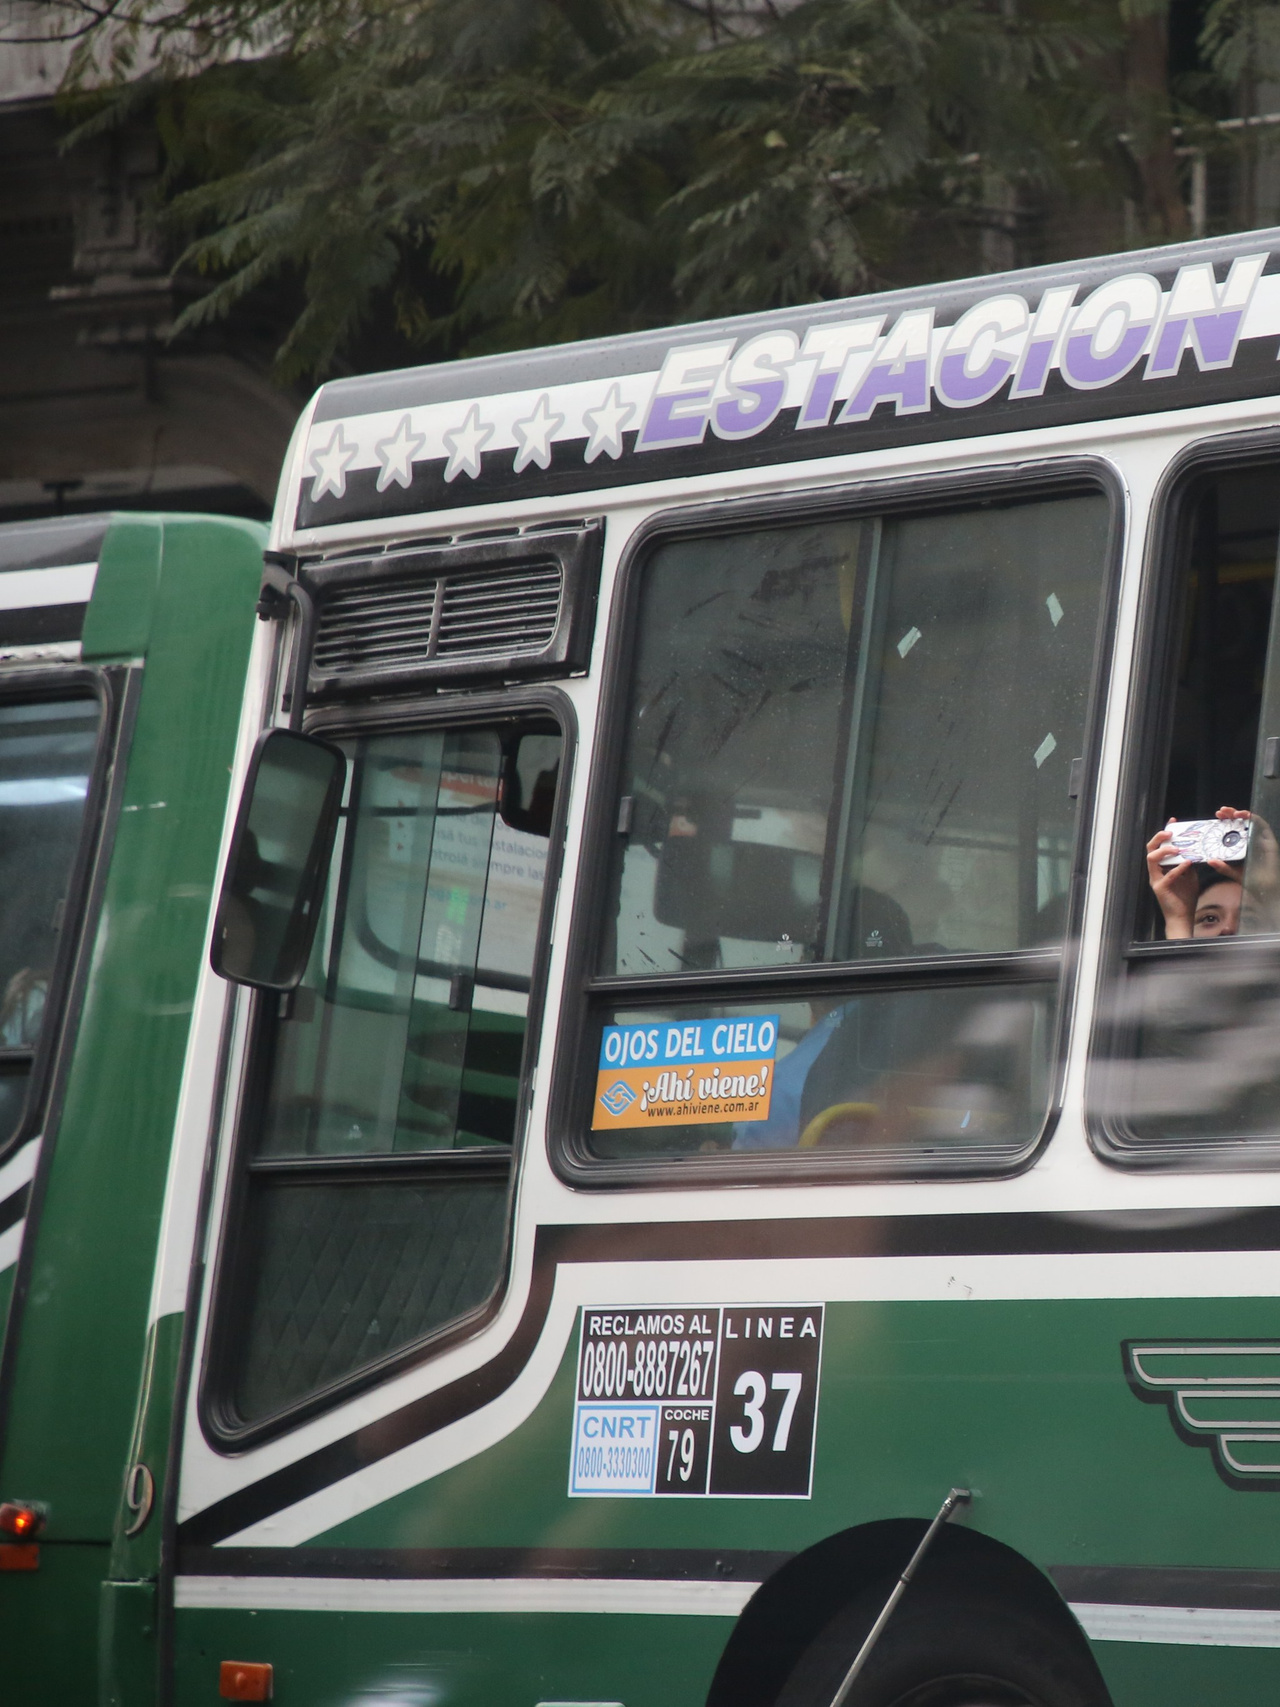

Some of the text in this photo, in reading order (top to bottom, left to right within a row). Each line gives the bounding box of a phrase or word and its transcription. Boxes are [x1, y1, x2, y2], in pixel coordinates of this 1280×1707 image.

[634, 252, 1270, 453] ESTACION
[604, 1021, 775, 1066] OJOS DEL CIELO
[698, 1065, 769, 1100] viene!
[647, 1101, 760, 1118] www.ahiviene.com.ar
[589, 1314, 712, 1336] RECLAMOS AL
[725, 1317, 817, 1339] LINEA
[582, 1340, 715, 1397] 0800-8887267
[583, 1416, 652, 1439] CNRT
[664, 1409, 710, 1421] COCHE
[729, 1370, 803, 1454] 37
[578, 1446, 651, 1479] 0800-3330300
[666, 1428, 695, 1482] 79
[124, 1463, 154, 1536] 9
